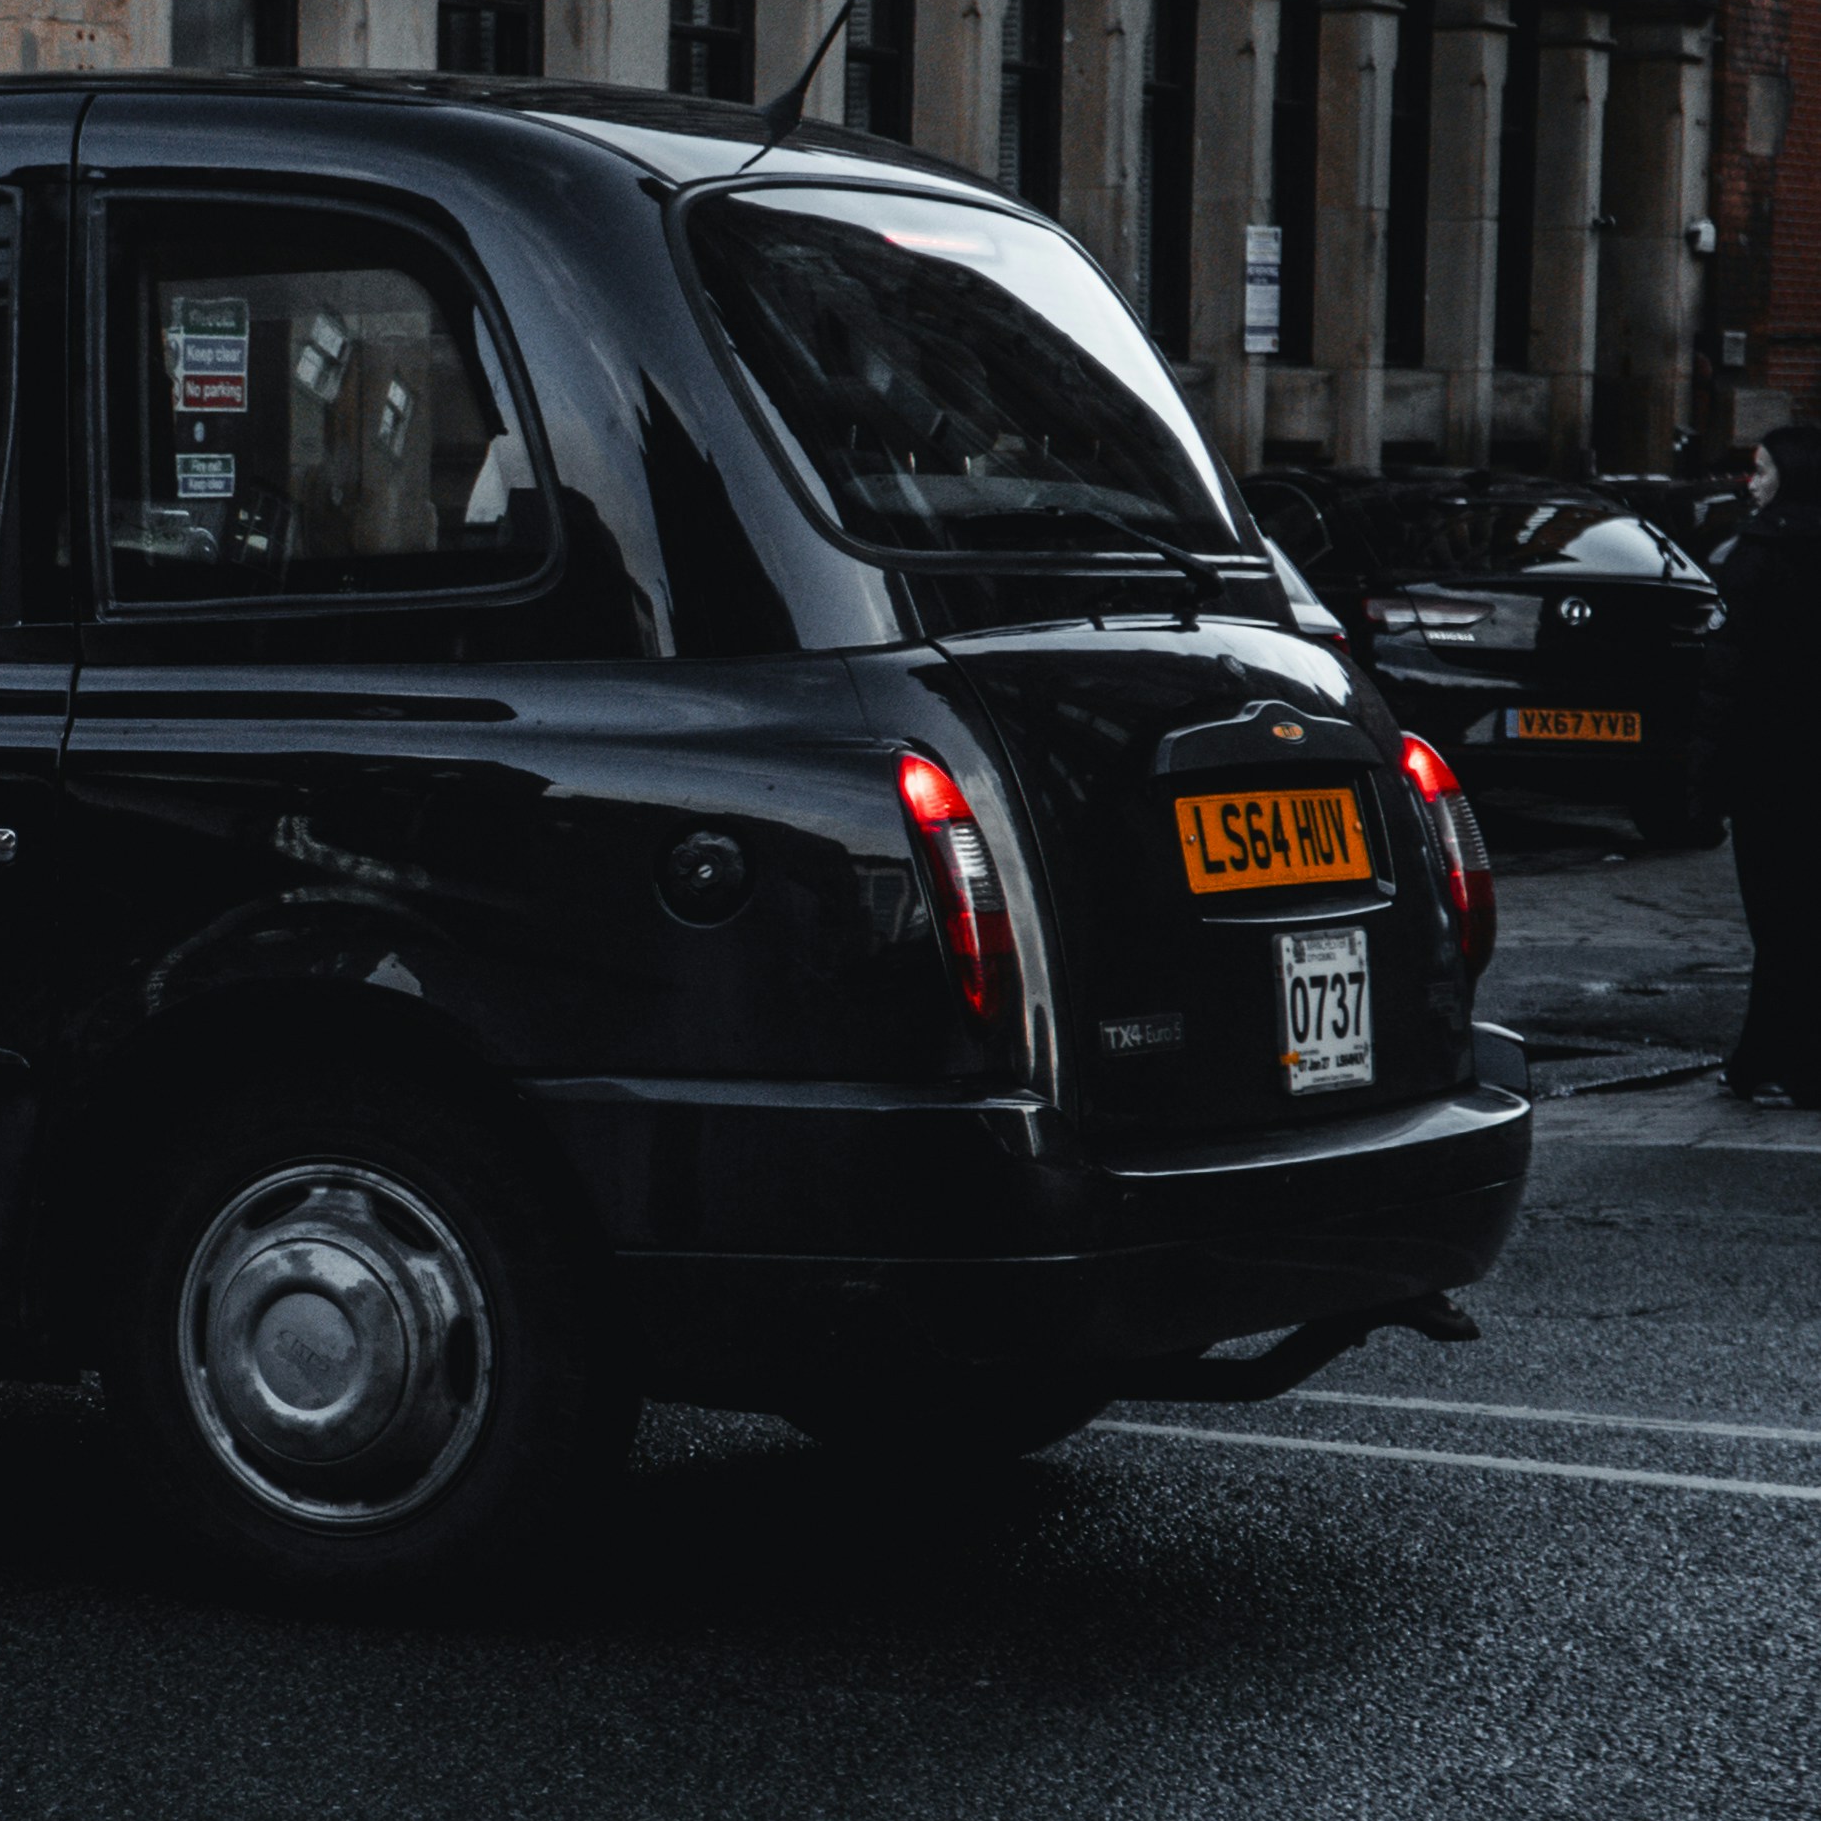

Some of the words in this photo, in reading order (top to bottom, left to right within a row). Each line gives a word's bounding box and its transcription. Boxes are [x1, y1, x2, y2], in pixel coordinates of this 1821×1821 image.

[186, 381, 201, 397] No
[203, 382, 242, 402] parking
[1522, 711, 1584, 735] VX67
[1591, 713, 1636, 737] YVB
[1194, 800, 1291, 875] LS64
[1292, 798, 1351, 866] HUV
[1290, 971, 1365, 1045] 0737
[1104, 1023, 1143, 1050] TX4
[1145, 1024, 1172, 1044] Euro
[1174, 1021, 1182, 1041] 5
